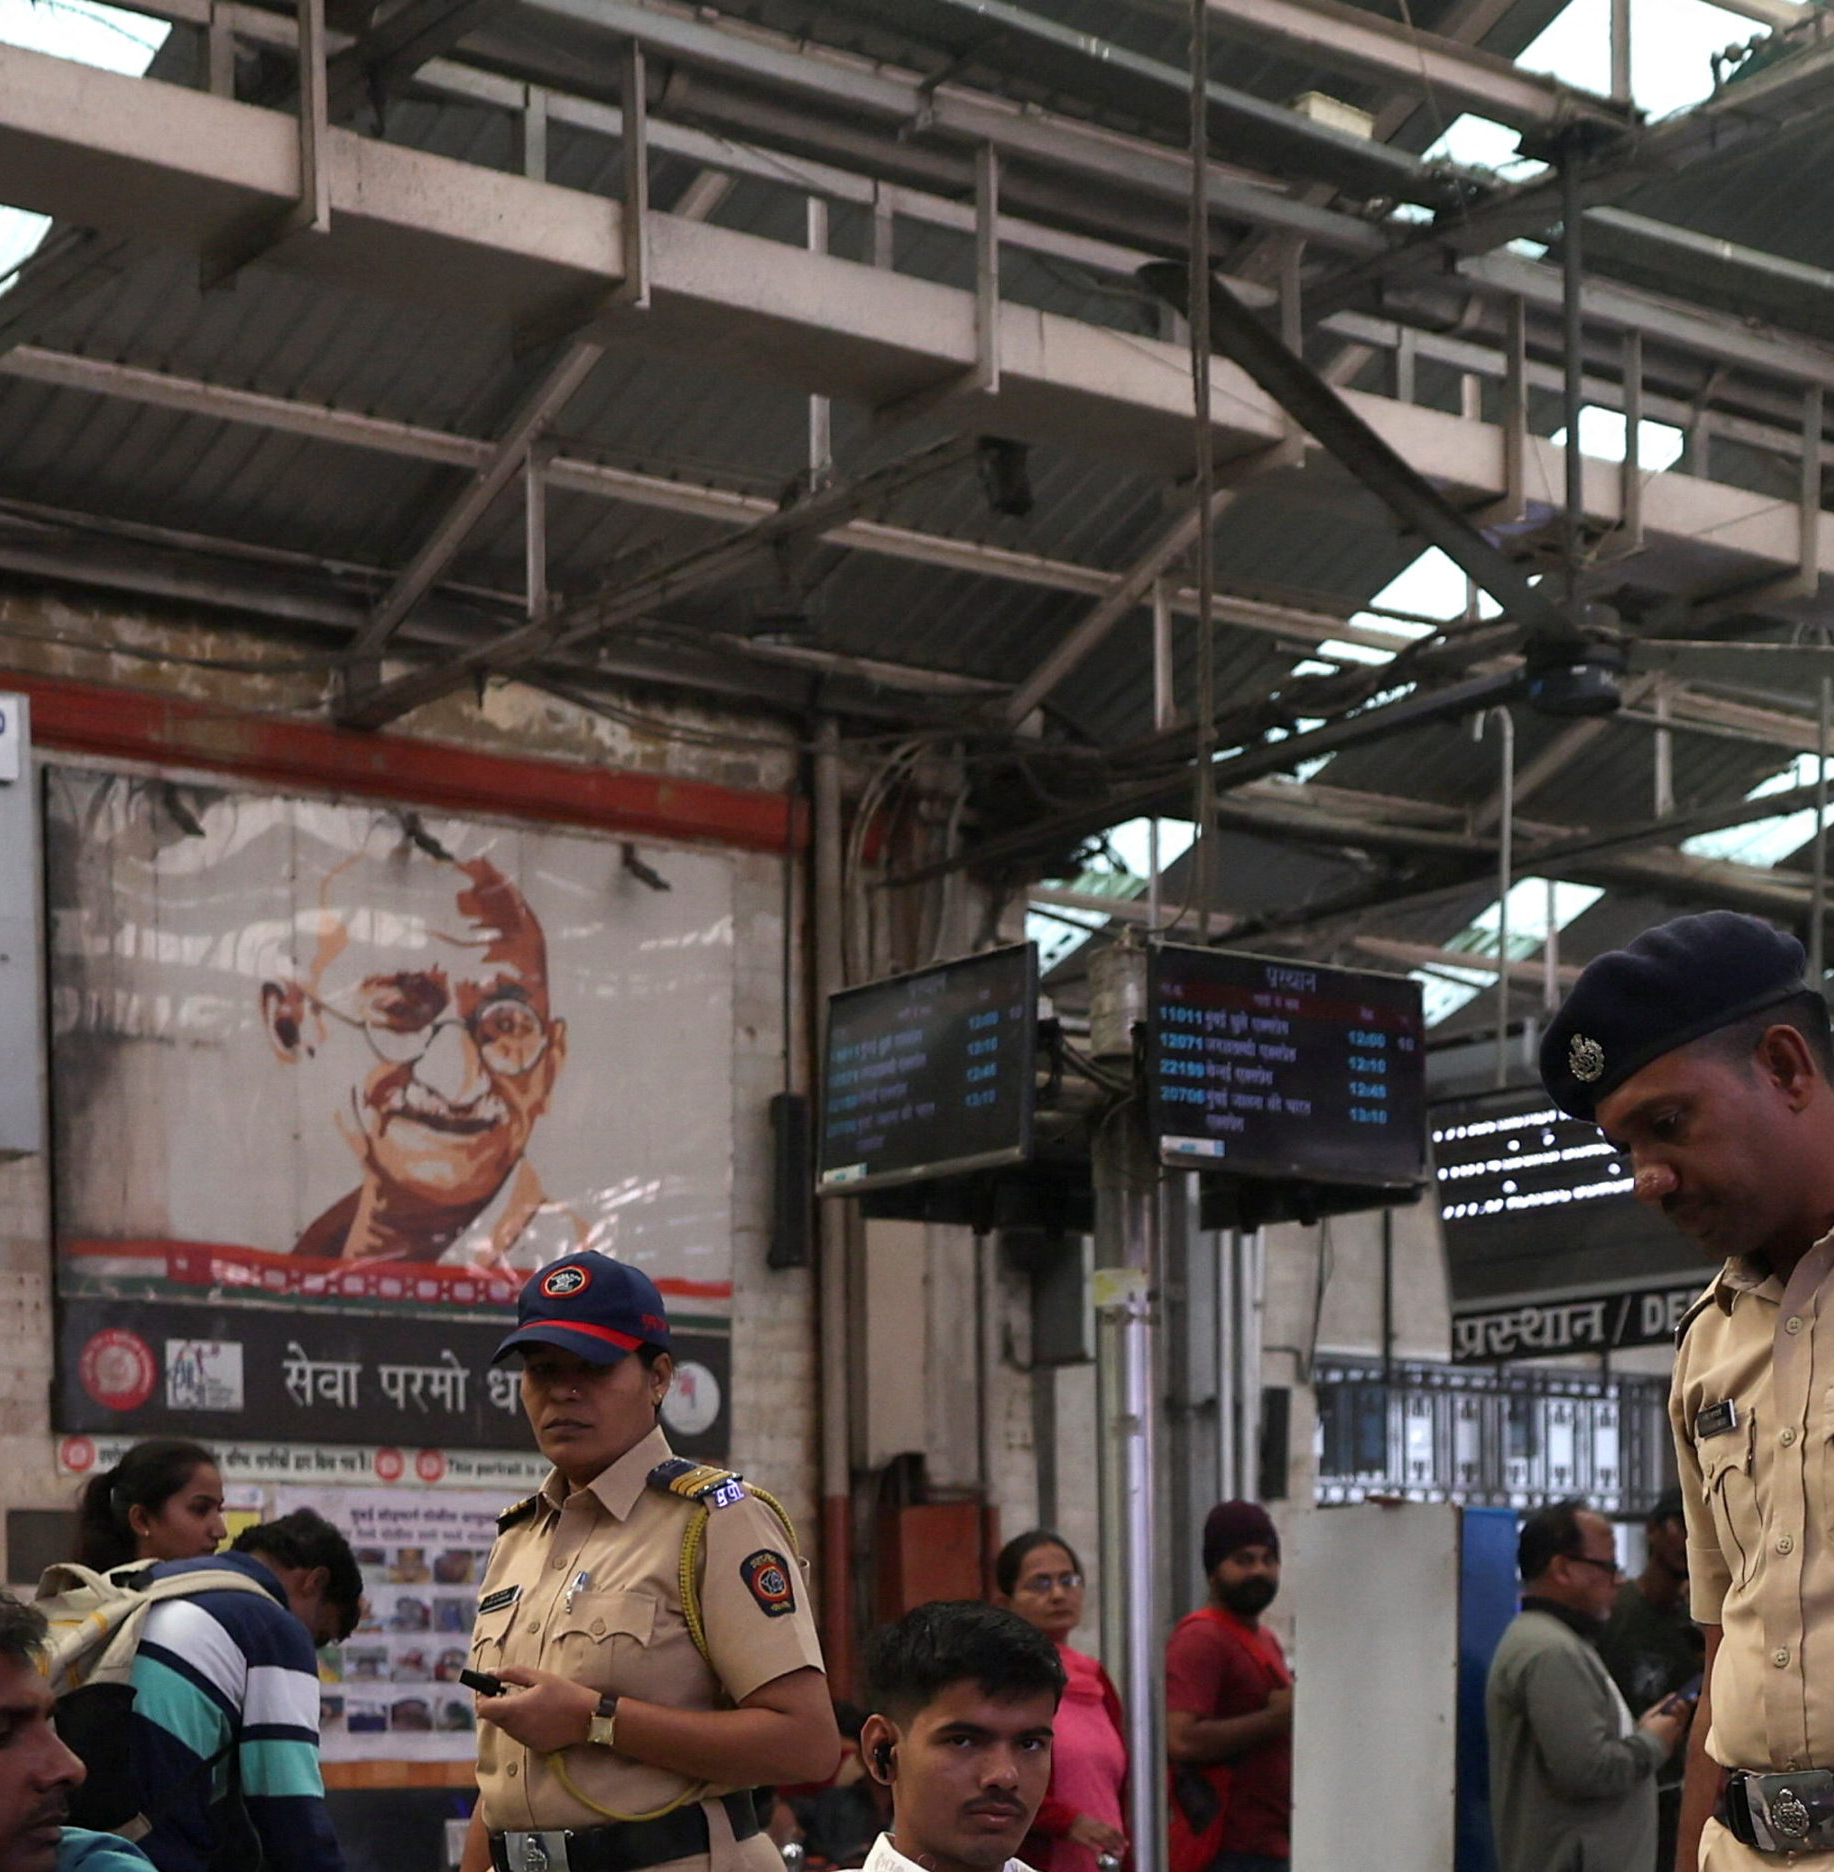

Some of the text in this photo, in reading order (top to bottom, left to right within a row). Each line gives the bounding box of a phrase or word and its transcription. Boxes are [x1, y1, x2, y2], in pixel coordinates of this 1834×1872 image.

[1454, 1300, 1607, 1359] प्रस्थान
[1641, 1293, 1688, 1337] DE
[283, 1341, 363, 1409] सेवा
[379, 1347, 470, 1416] परमो
